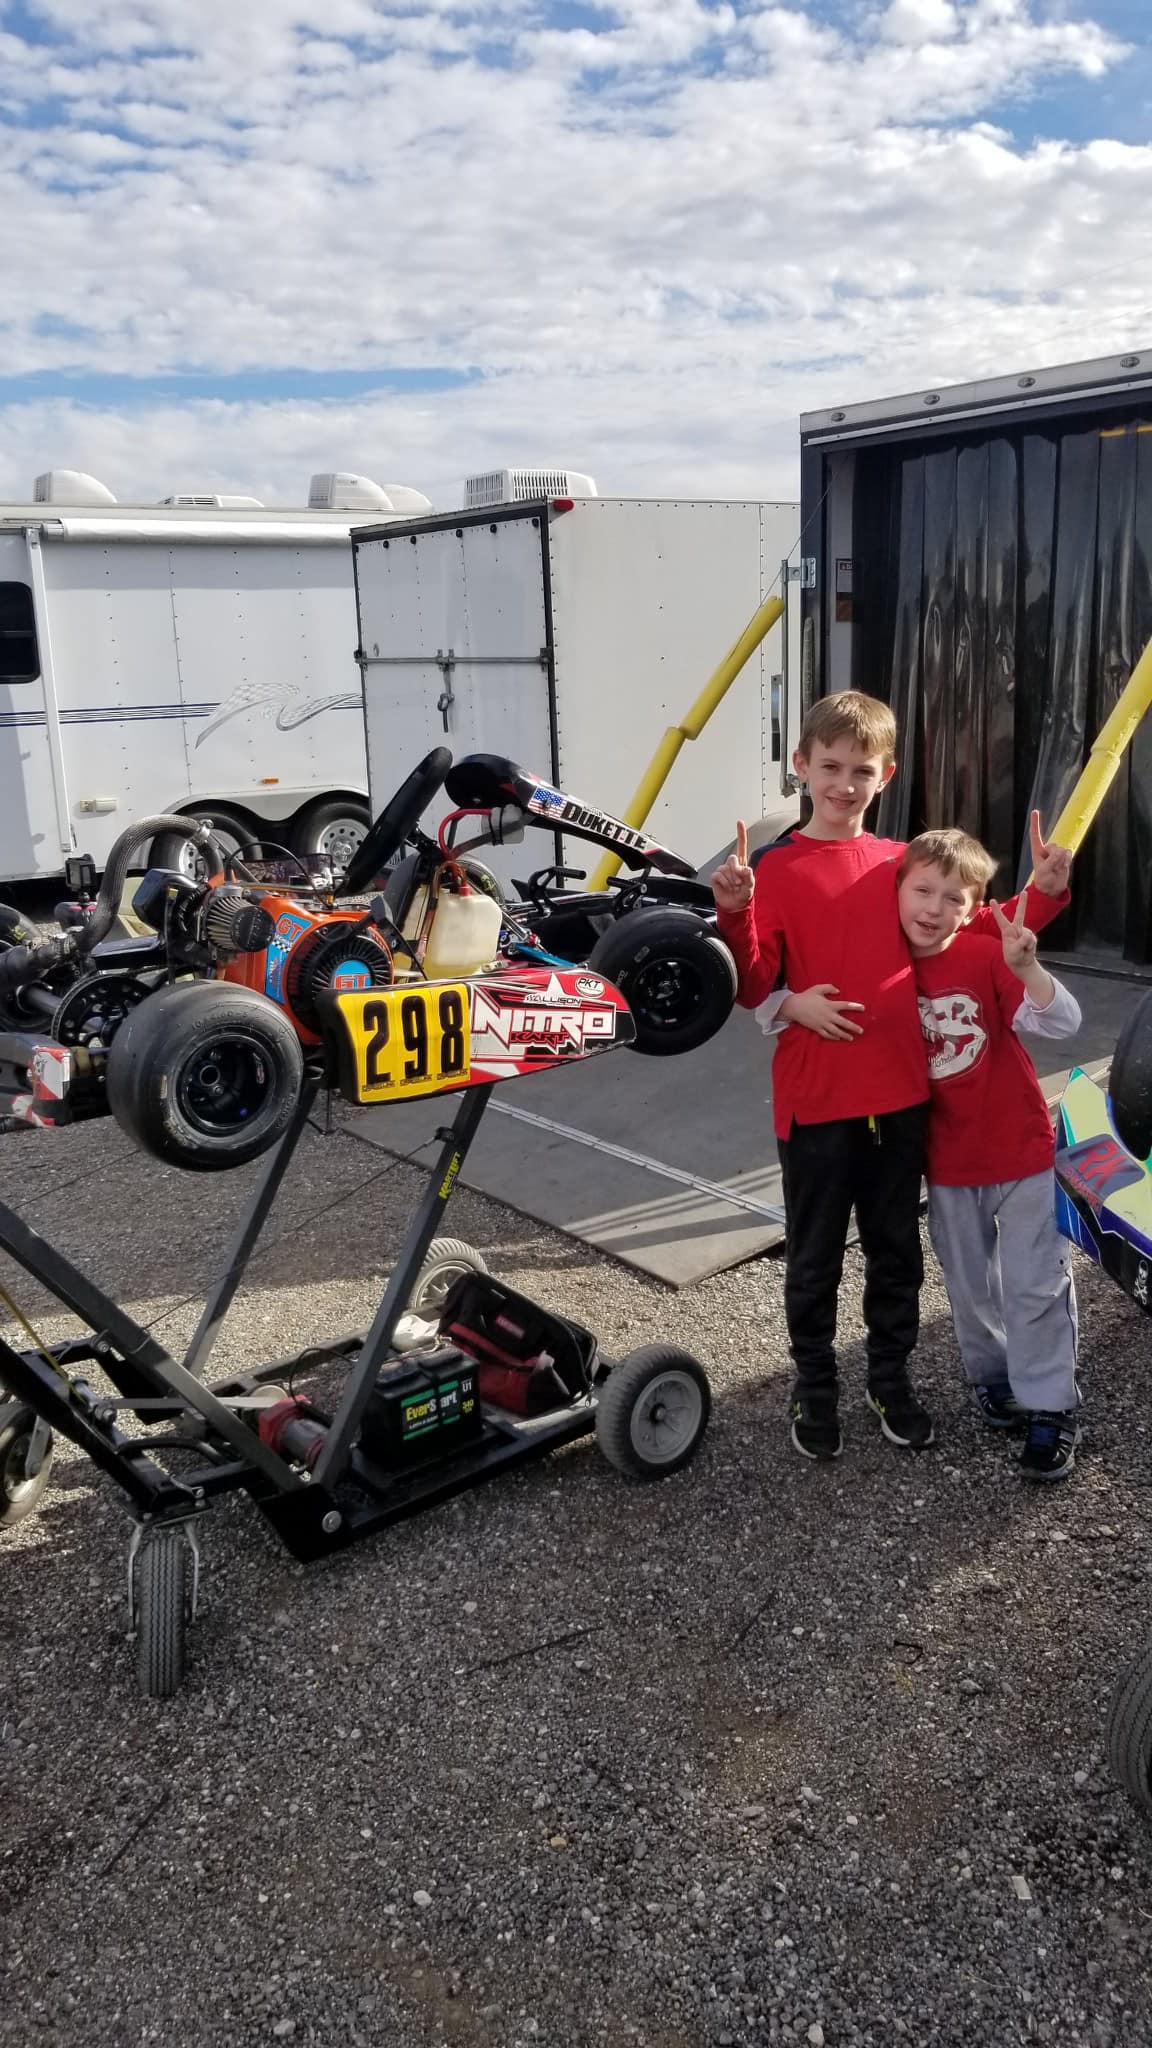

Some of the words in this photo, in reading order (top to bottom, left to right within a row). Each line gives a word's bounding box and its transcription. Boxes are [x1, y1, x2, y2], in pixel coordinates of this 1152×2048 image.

[561, 800, 647, 849] DUKETTE
[277, 918, 303, 940] GT
[577, 978, 602, 989] PKT
[472, 991, 615, 1050] NITRO
[363, 990, 465, 1085] 298
[510, 1031, 570, 1047] KART
[405, 1391, 458, 1422] EverSart
